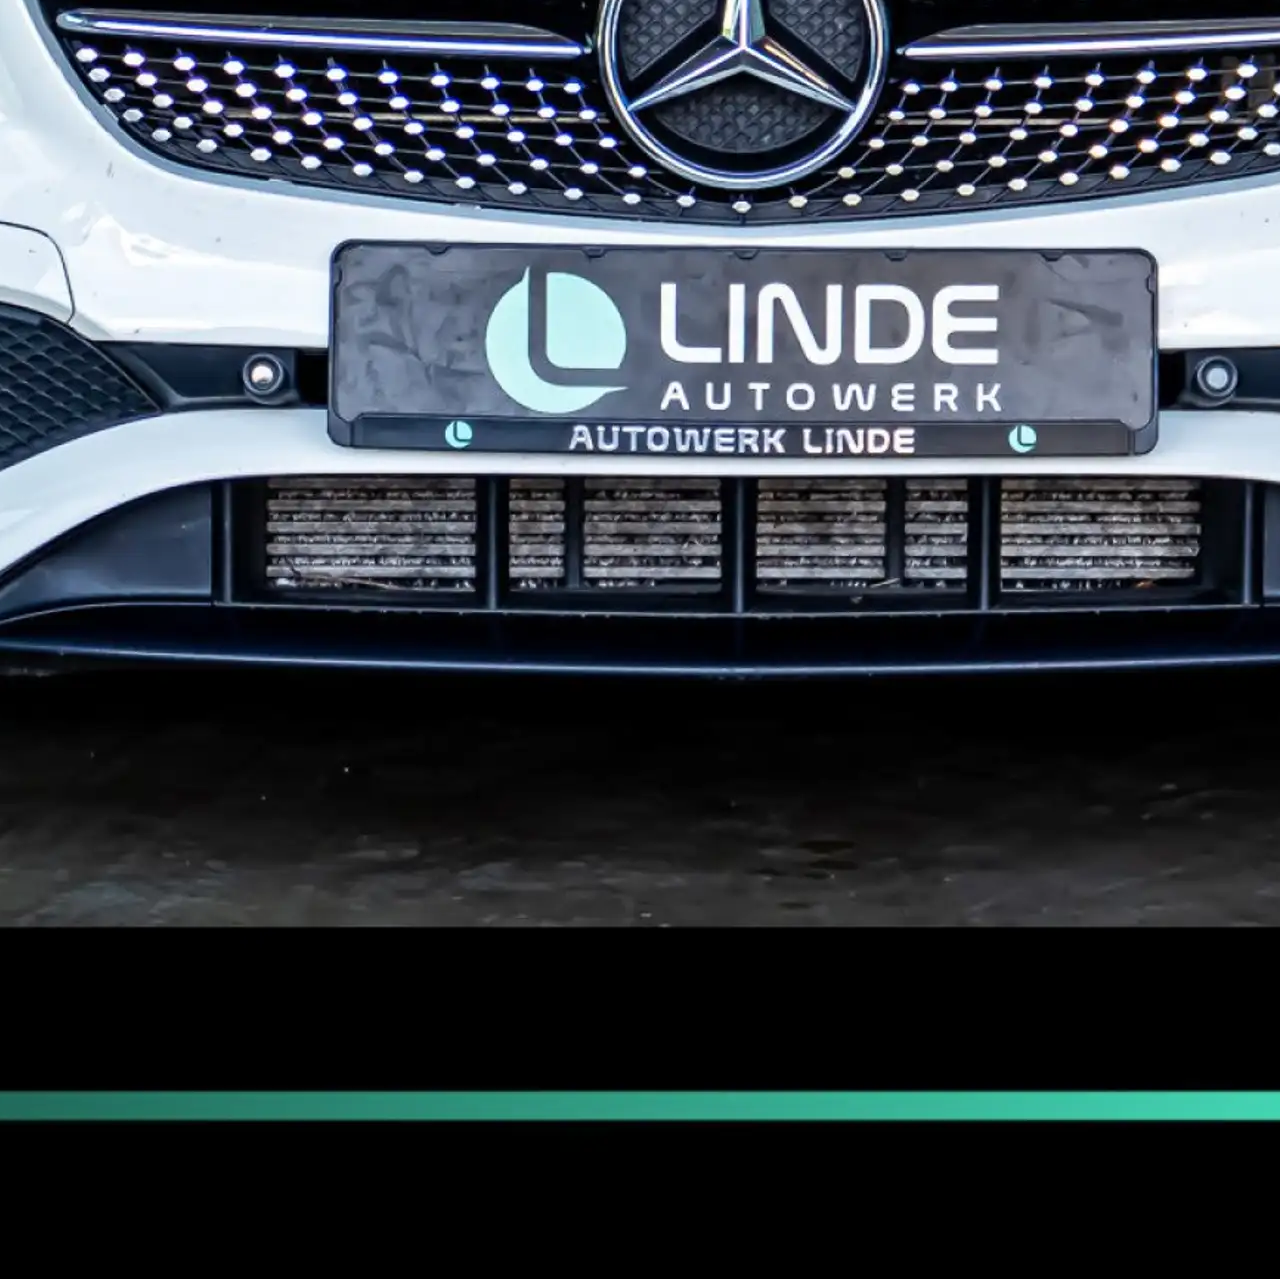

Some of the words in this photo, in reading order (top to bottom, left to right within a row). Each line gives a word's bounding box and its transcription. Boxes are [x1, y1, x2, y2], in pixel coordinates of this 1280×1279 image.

[660, 281, 1000, 366] LINDE
[660, 380, 1003, 412] AUTOWERK
[569, 424, 787, 453] AUTOWERK
[802, 427, 916, 454] LINDE
